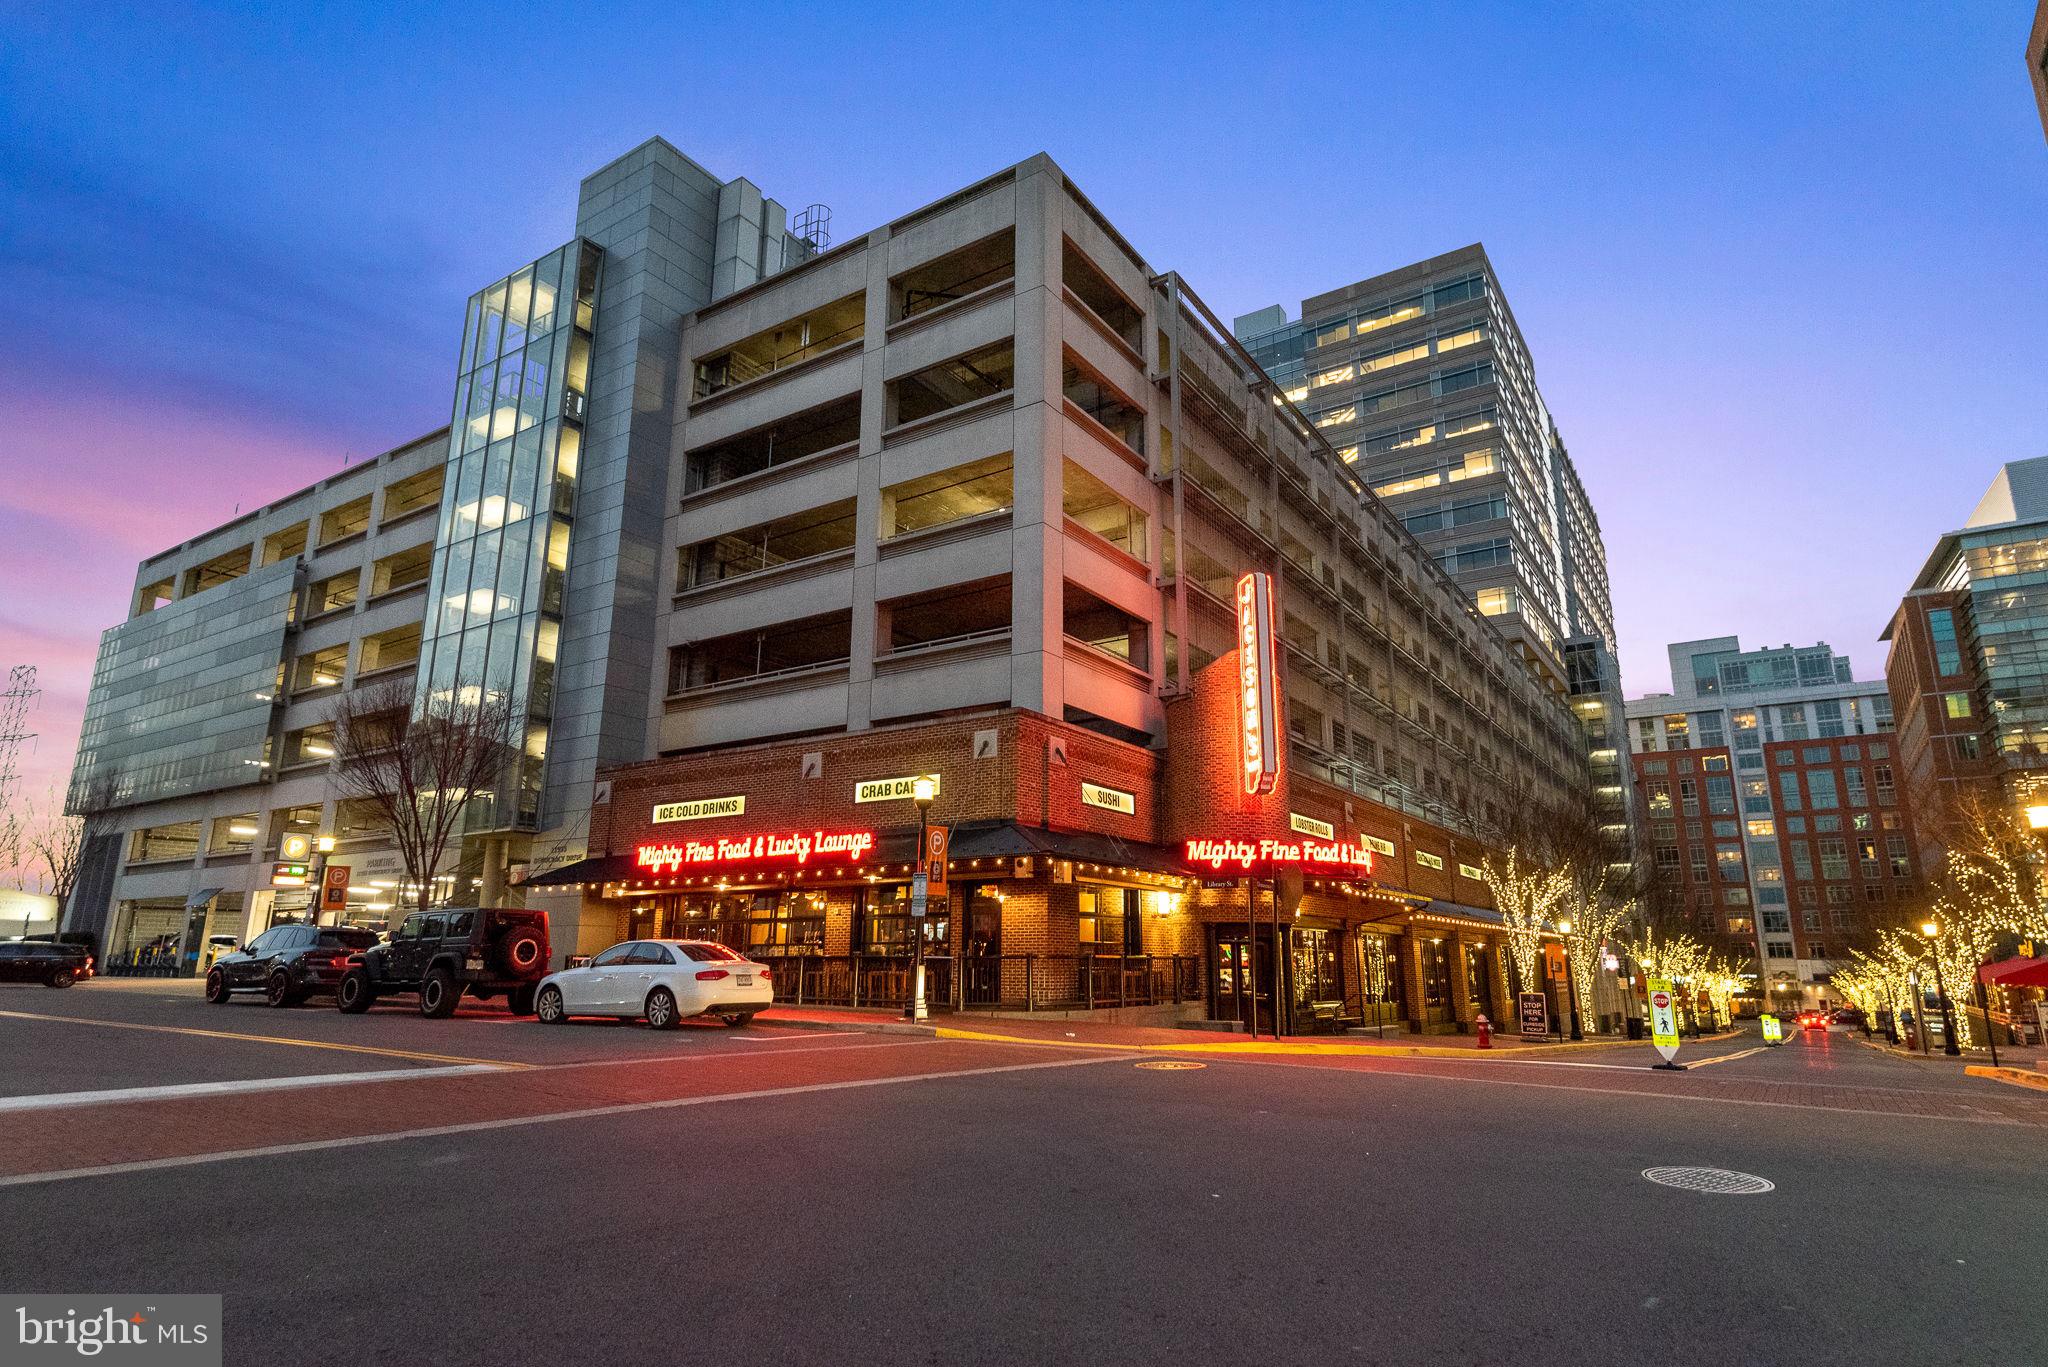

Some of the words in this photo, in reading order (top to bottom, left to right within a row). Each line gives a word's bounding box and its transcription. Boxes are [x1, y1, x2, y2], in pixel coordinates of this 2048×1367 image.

[861, 783, 891, 798] CRAB
[1097, 790, 1120, 807] SUSHI
[659, 806, 674, 819] ICE
[676, 803, 700, 817] COLD
[702, 800, 738, 815] DRINKS
[1295, 816, 1314, 833] LOBSTER
[1315, 822, 1329, 836] ROLLS
[638, 845, 682, 873] Mighty
[685, 842, 714, 863] Fine
[717, 837, 751, 860] Food
[753, 836, 764, 857] &
[767, 833, 811, 863] Lucky
[814, 831, 872, 860] Lounge
[1186, 840, 1257, 869] Mighty
[1260, 840, 1300, 860] Fine
[1302, 841, 1340, 862] Food
[1341, 843, 1349, 863] &
